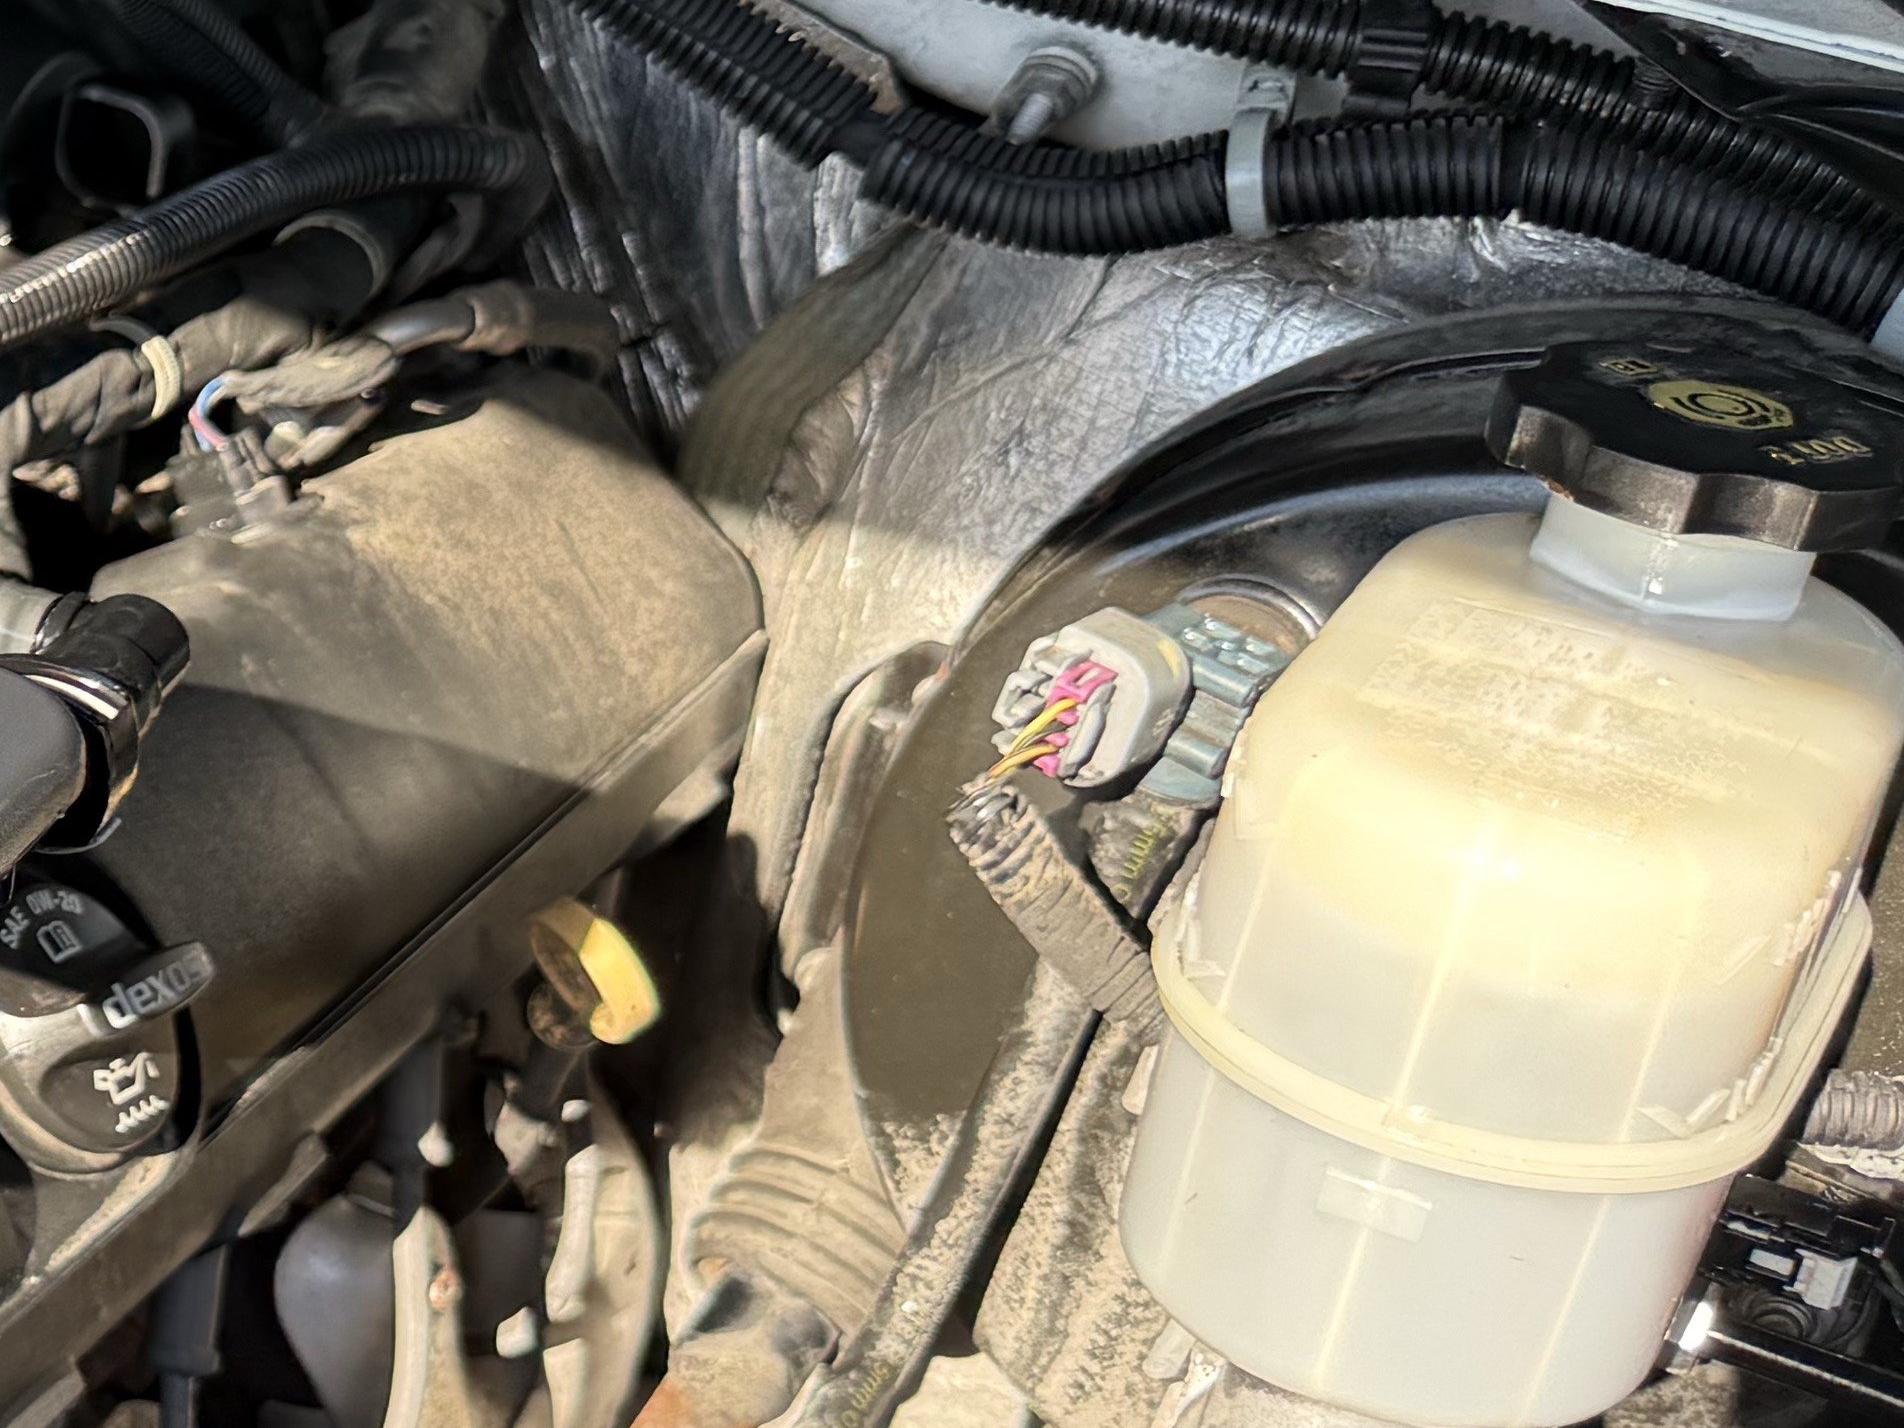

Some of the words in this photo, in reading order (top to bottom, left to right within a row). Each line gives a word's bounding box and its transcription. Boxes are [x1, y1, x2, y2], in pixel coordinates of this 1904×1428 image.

[0, 905, 30, 950] SAE
[26, 889, 83, 915] 0W-20
[102, 950, 211, 1029] dexos
